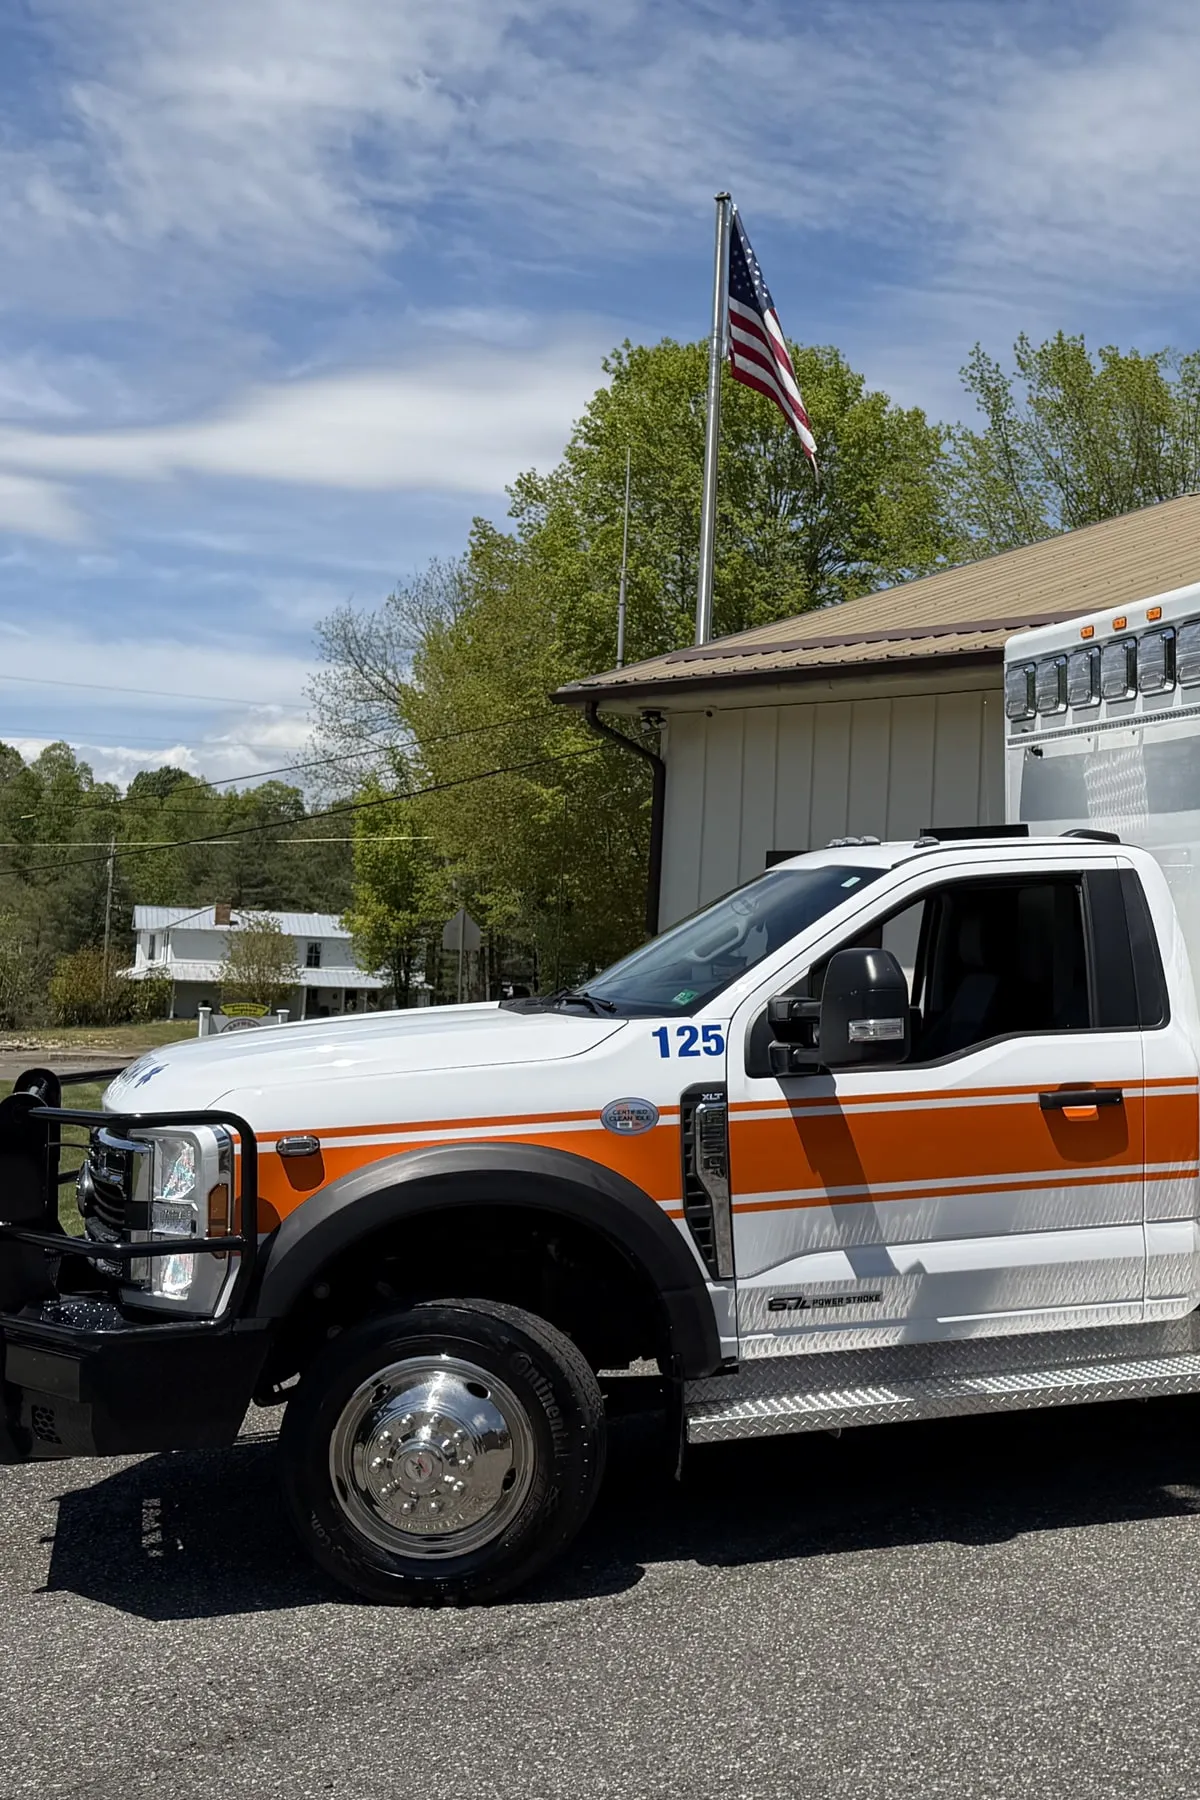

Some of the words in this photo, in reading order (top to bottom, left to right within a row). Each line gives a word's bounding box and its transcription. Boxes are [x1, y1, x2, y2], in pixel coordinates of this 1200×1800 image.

[652, 1025, 725, 1058] 125
[702, 1092, 723, 1101] XLT
[768, 1296, 811, 1312] 6.7L
[812, 1297, 844, 1308] POWER
[845, 1294, 881, 1304] STROKE
